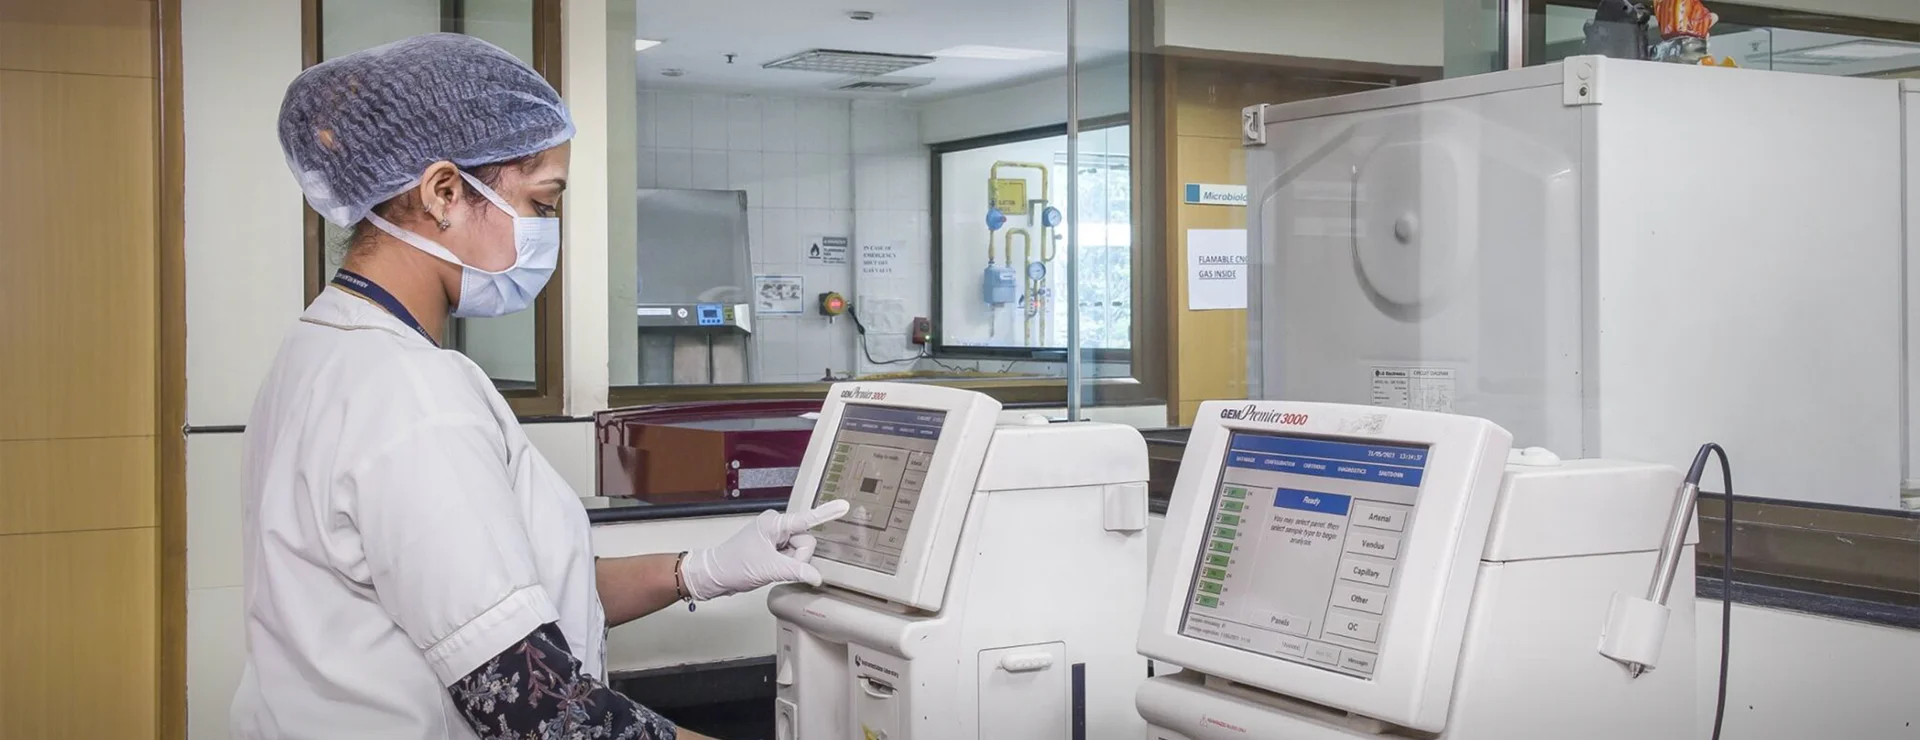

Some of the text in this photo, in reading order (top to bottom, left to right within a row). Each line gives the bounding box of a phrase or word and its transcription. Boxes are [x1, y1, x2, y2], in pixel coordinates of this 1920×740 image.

[1221, 404, 1308, 425] GEM Premier 3000
[1378, 470, 1404, 478] SHUTDOWN
[1303, 496, 1321, 507] Ready
[1274, 514, 1283, 522] You
[1369, 512, 1391, 523] Arterial
[1353, 566, 1379, 579] Capillary
[1351, 594, 1368, 604] Other
[1271, 616, 1290, 627] Panels
[1347, 622, 1358, 631] QC
